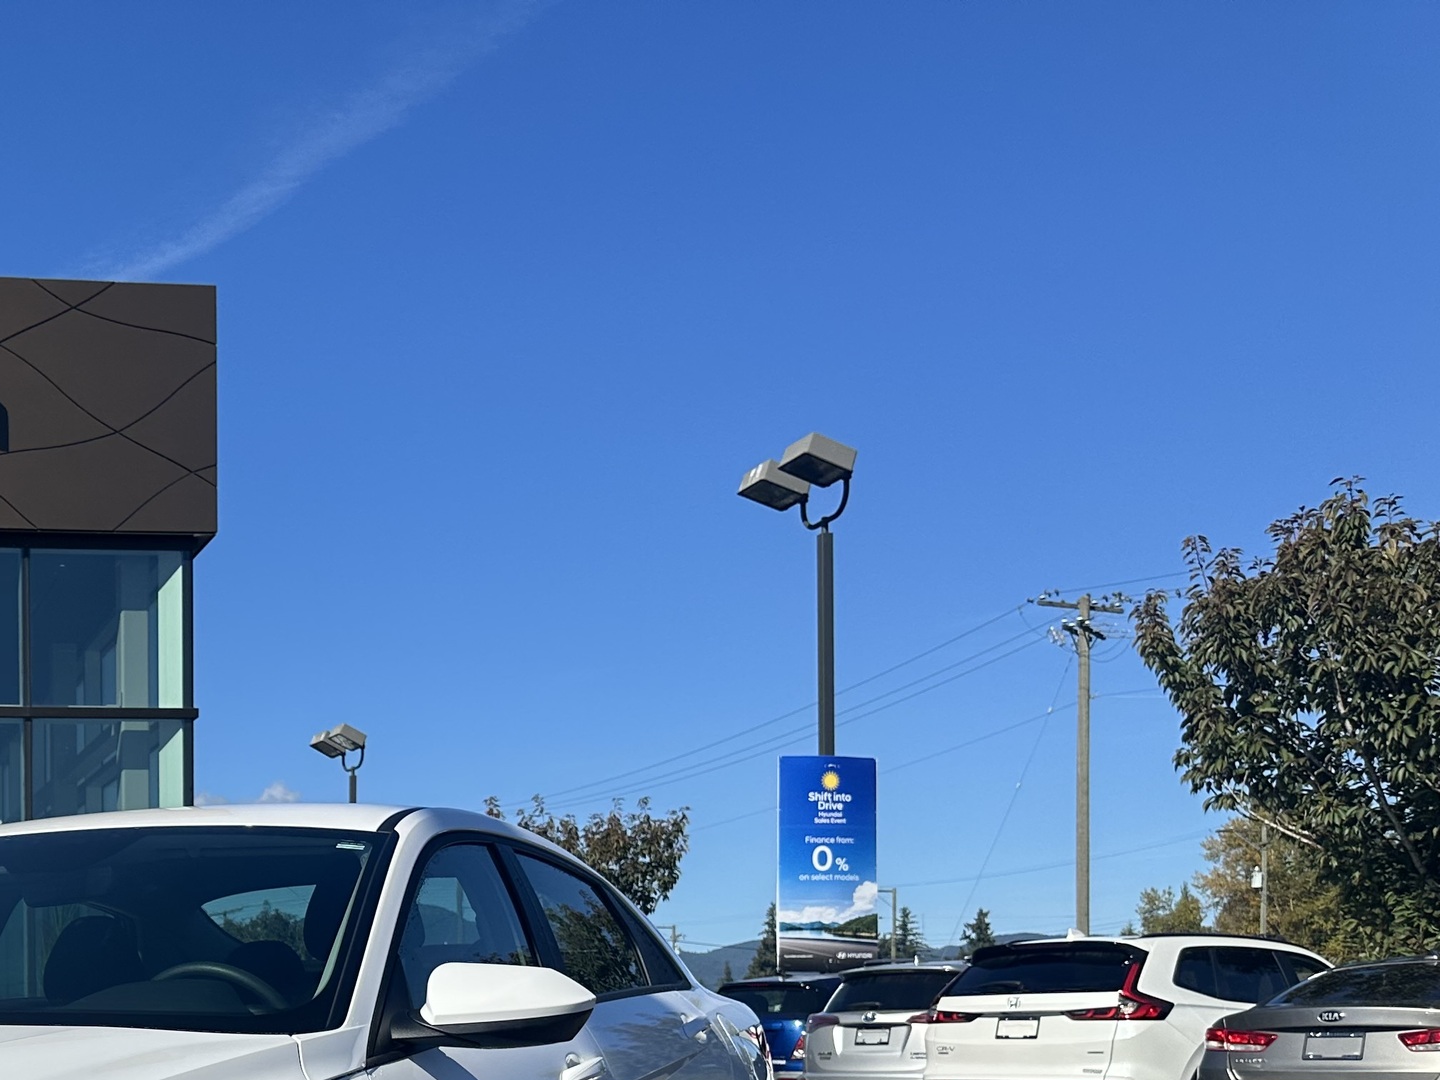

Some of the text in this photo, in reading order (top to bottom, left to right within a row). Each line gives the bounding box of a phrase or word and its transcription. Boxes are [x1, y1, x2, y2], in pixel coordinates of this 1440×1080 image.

[808, 791, 852, 802] Shift into
[818, 801, 843, 811] Drive
[804, 835, 835, 844] Finance
[811, 873, 833, 881] select
[834, 873, 860, 881] models
[1321, 1012, 1340, 1021] KIA
